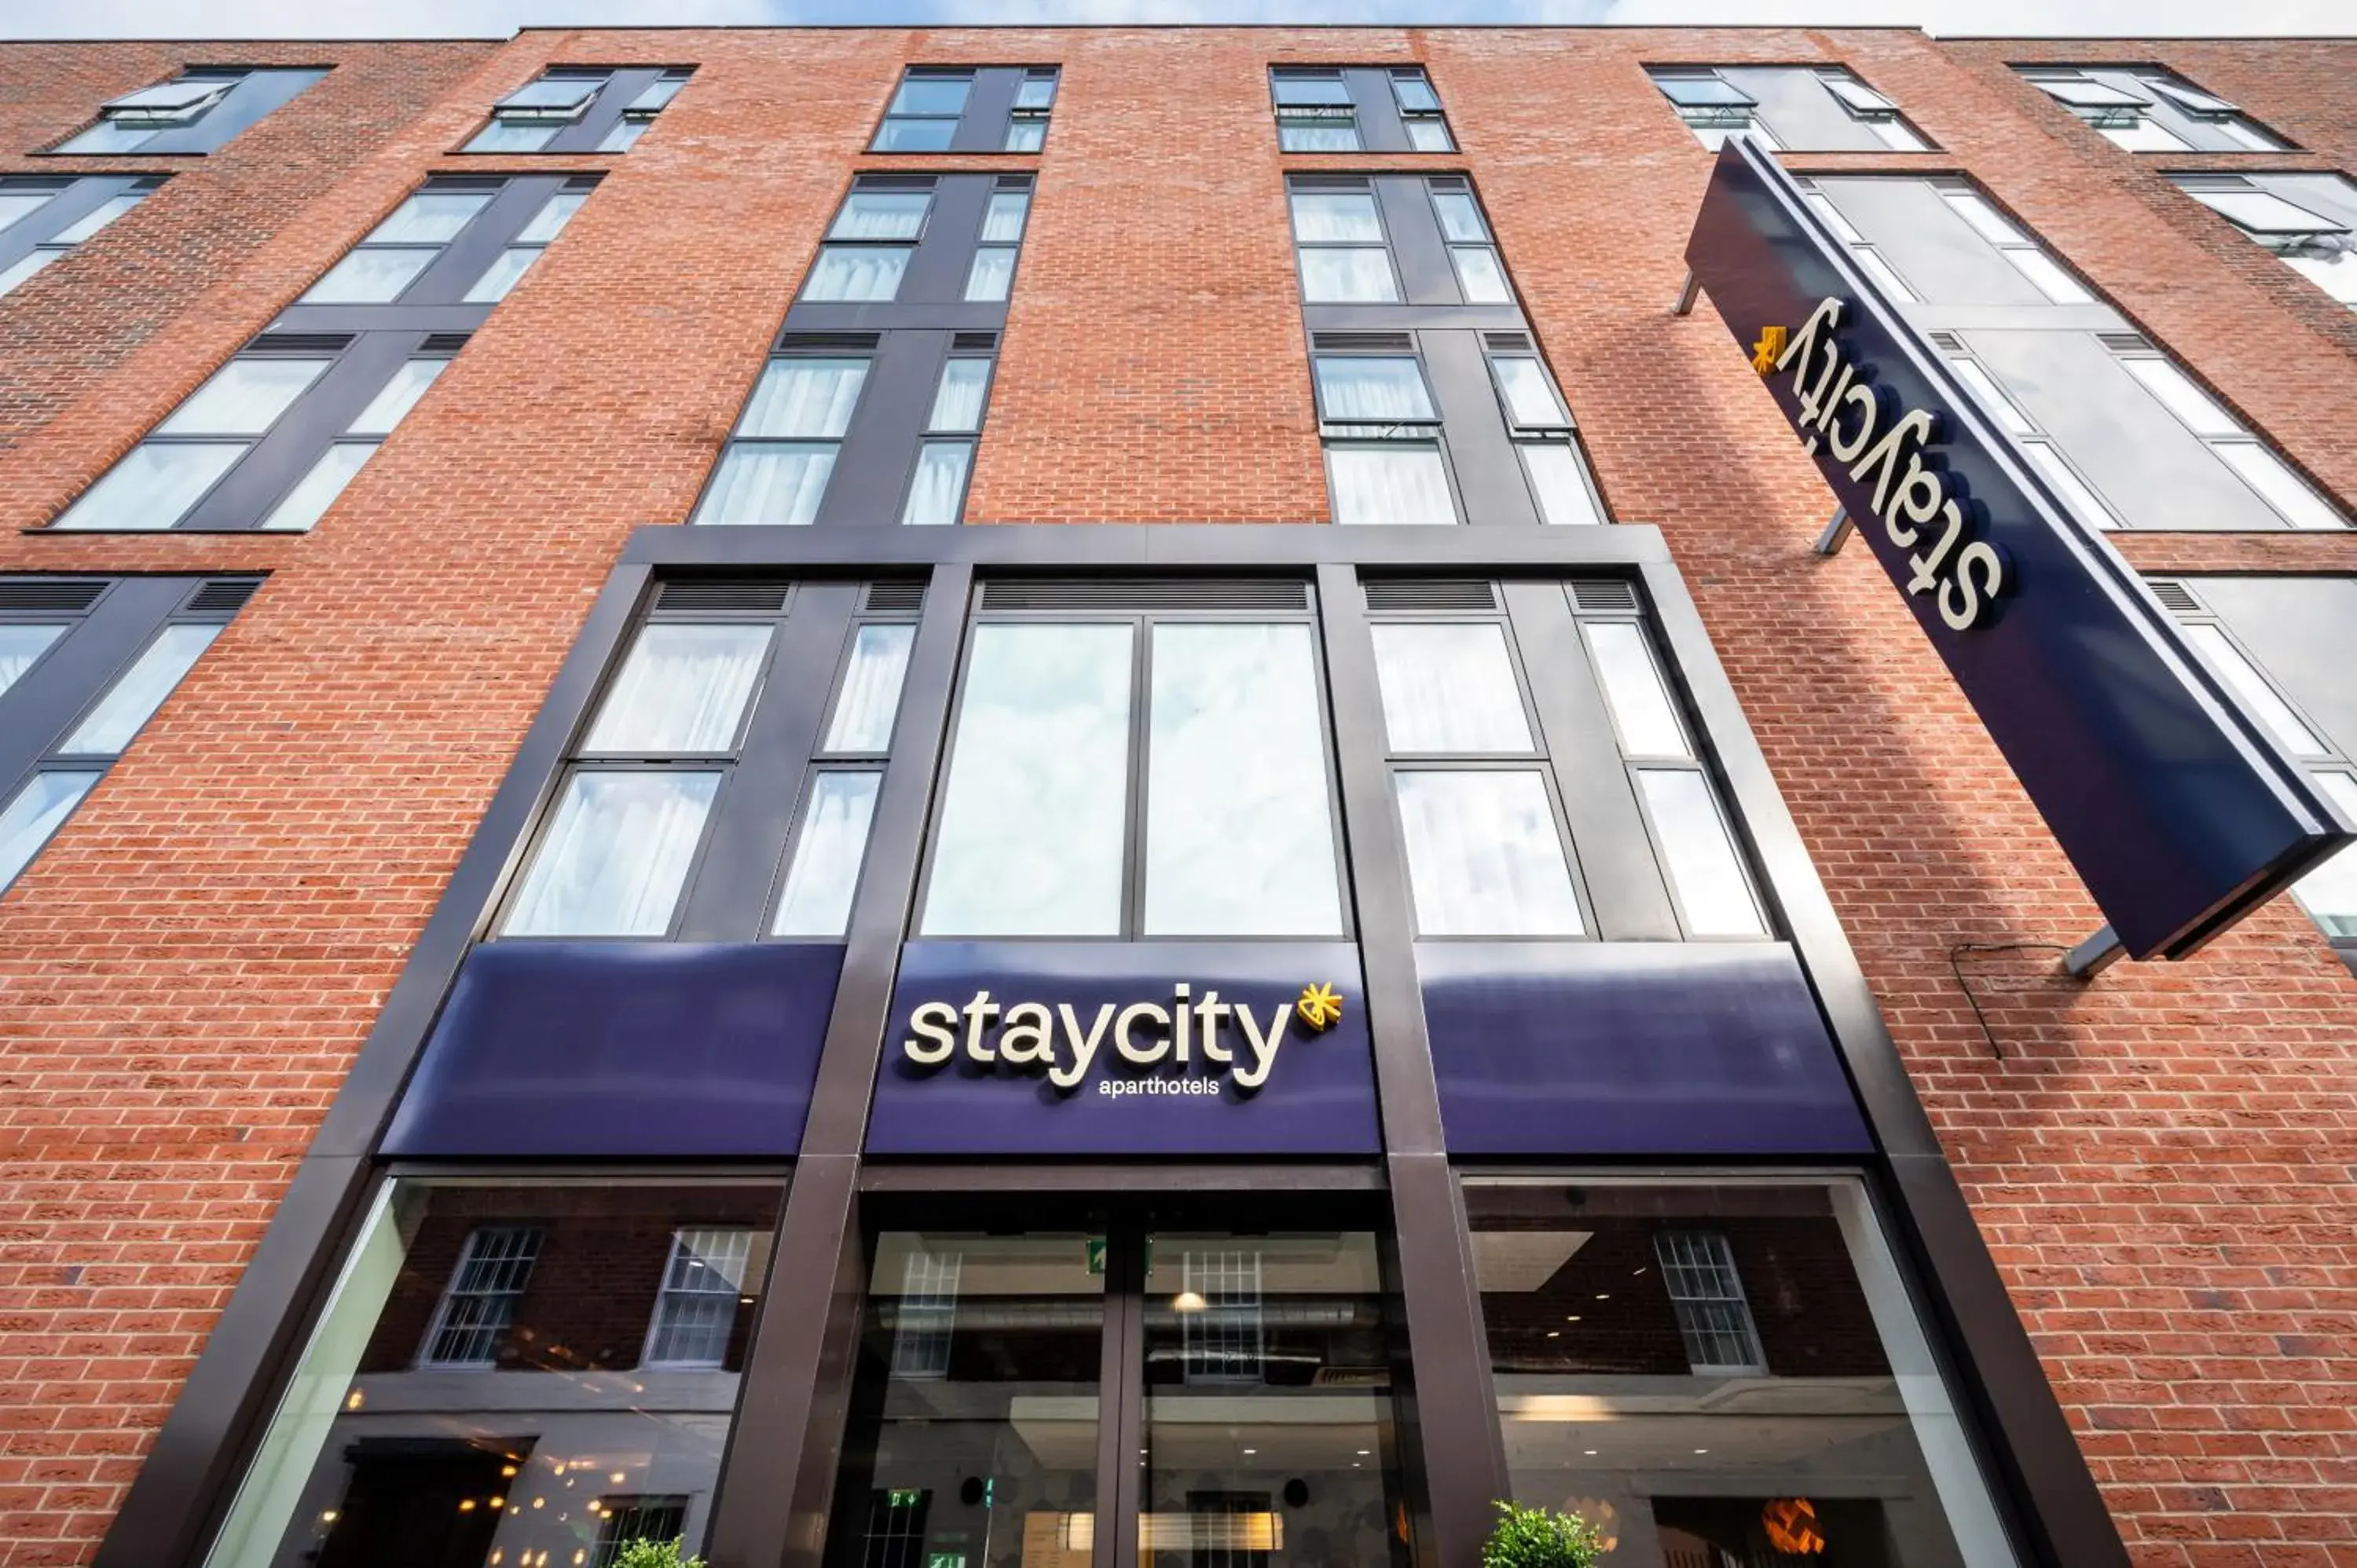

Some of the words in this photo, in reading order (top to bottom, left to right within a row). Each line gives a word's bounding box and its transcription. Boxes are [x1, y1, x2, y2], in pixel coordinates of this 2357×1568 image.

[1776, 296, 2001, 631] staycity
[904, 984, 1292, 1087] staycity
[1099, 1076, 1220, 1100] aparthotels
